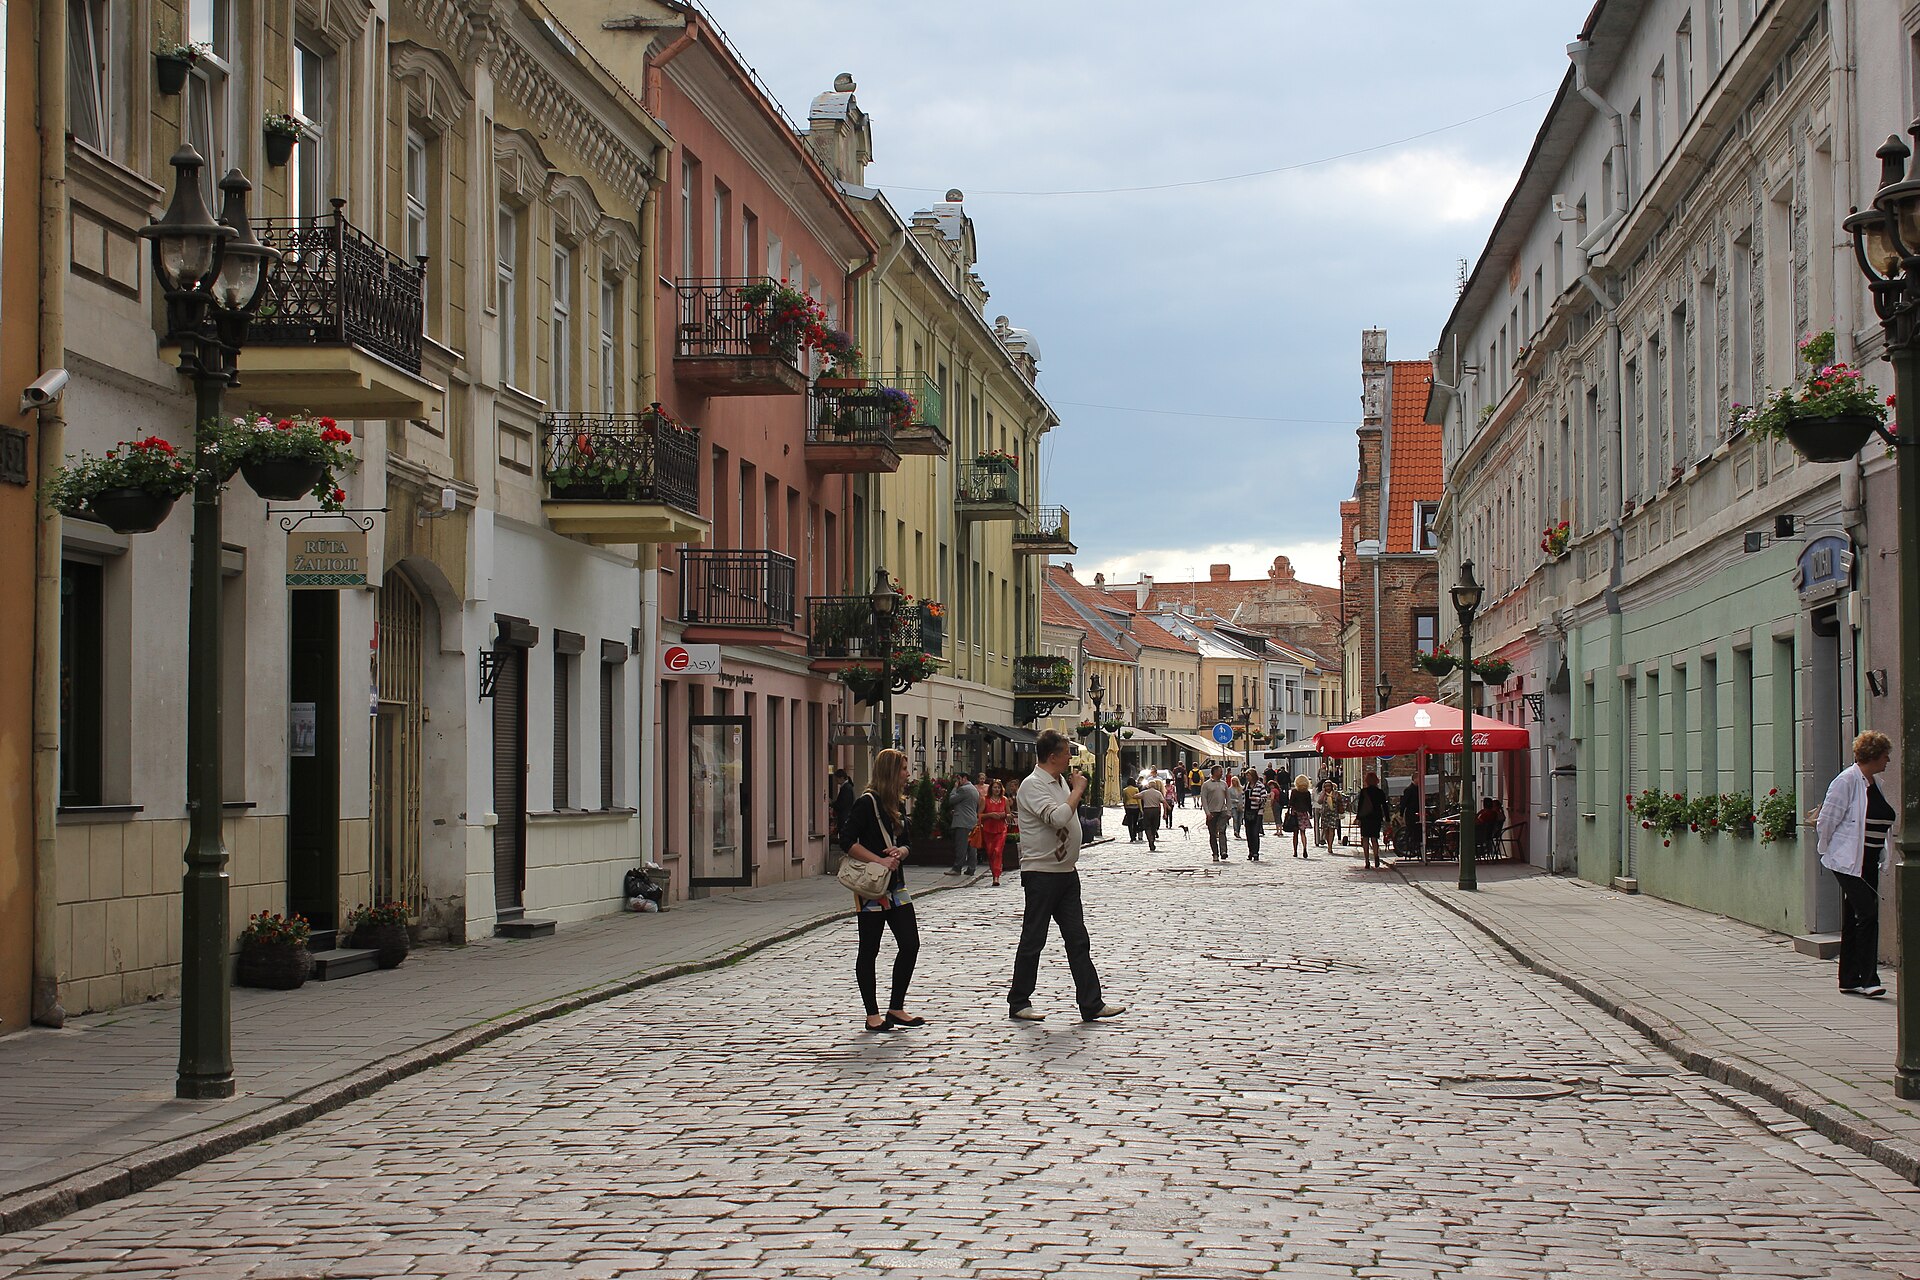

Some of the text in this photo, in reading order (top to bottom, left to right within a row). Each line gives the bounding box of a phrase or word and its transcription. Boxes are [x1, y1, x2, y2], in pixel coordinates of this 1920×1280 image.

[305, 539, 348, 553] RŪTA
[294, 555, 359, 571] ŽALIOJI
[1347, 735, 1387, 748] Coca-Cola
[1451, 732, 1490, 746] CocCola
